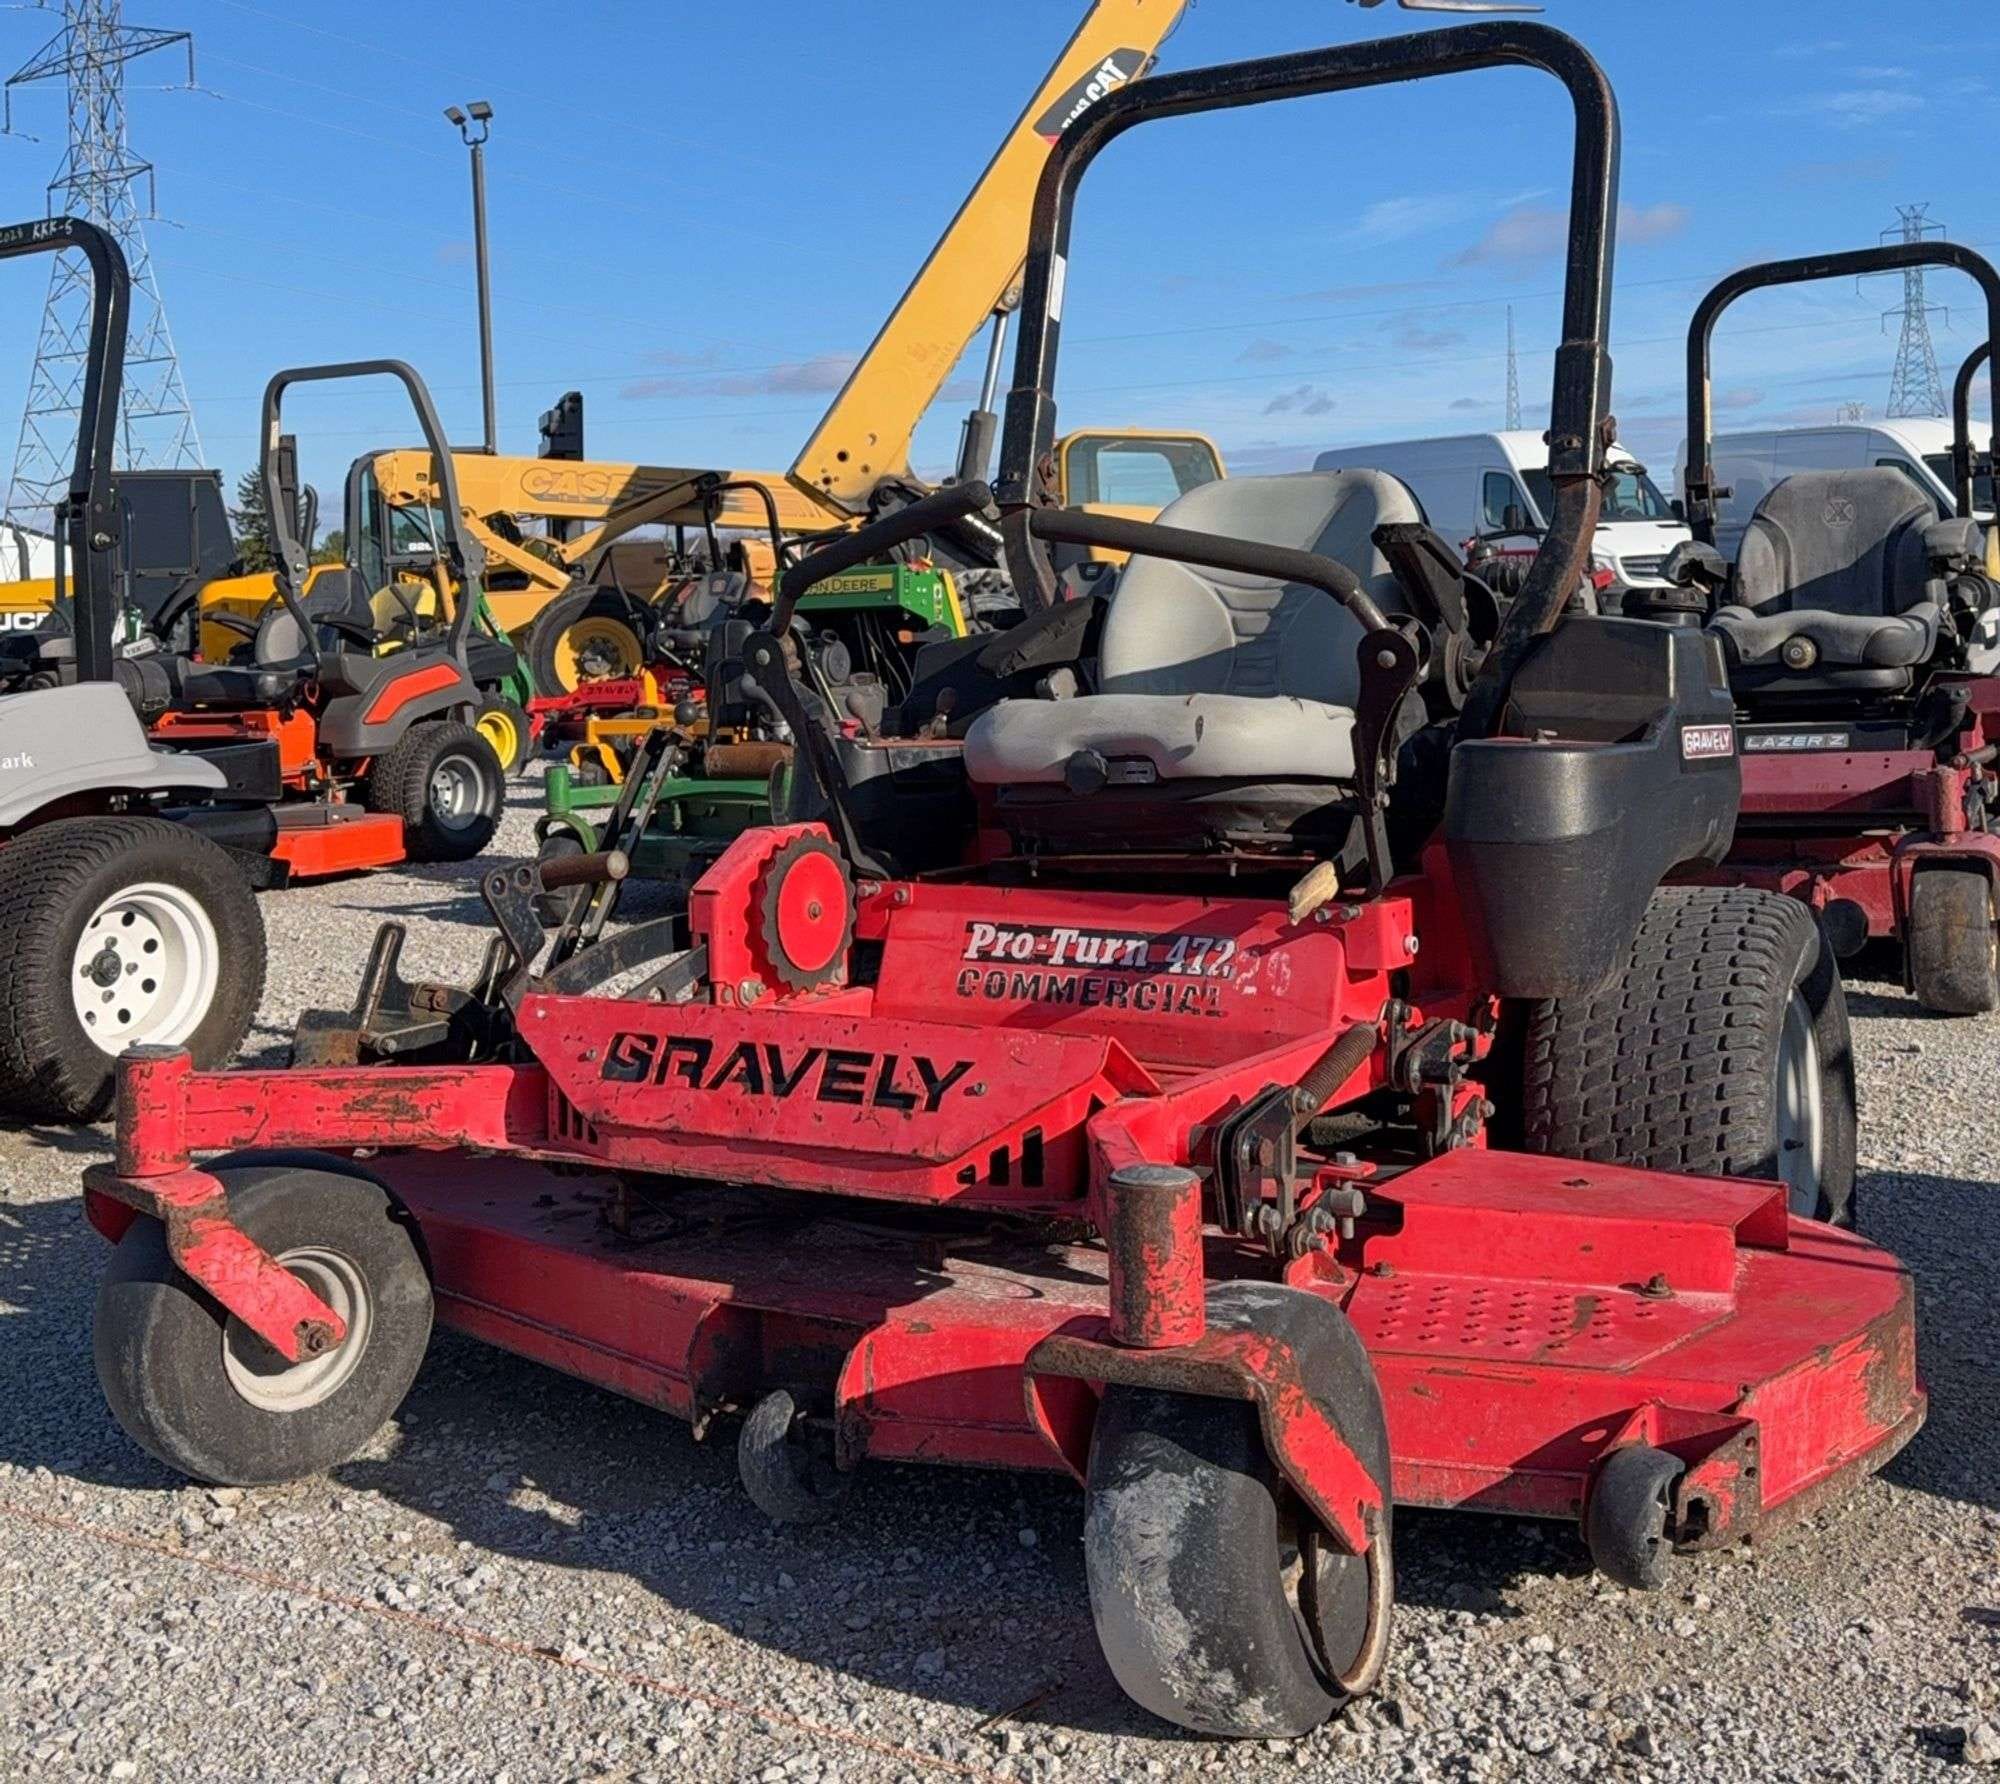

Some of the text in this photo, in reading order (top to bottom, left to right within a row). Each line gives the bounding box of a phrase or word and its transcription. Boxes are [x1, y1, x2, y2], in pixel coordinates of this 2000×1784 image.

[1085, 57, 1129, 102] CAT
[520, 467, 641, 502] CASE
[831, 577, 879, 593] DEERE
[1684, 730, 1731, 754] GRAVELY
[1747, 735, 1846, 749] LAZER Z
[962, 923, 1239, 978] Pro-Turn 472
[956, 968, 1229, 1018] COMMERCIAL
[600, 1031, 976, 1113] GRAVELY
